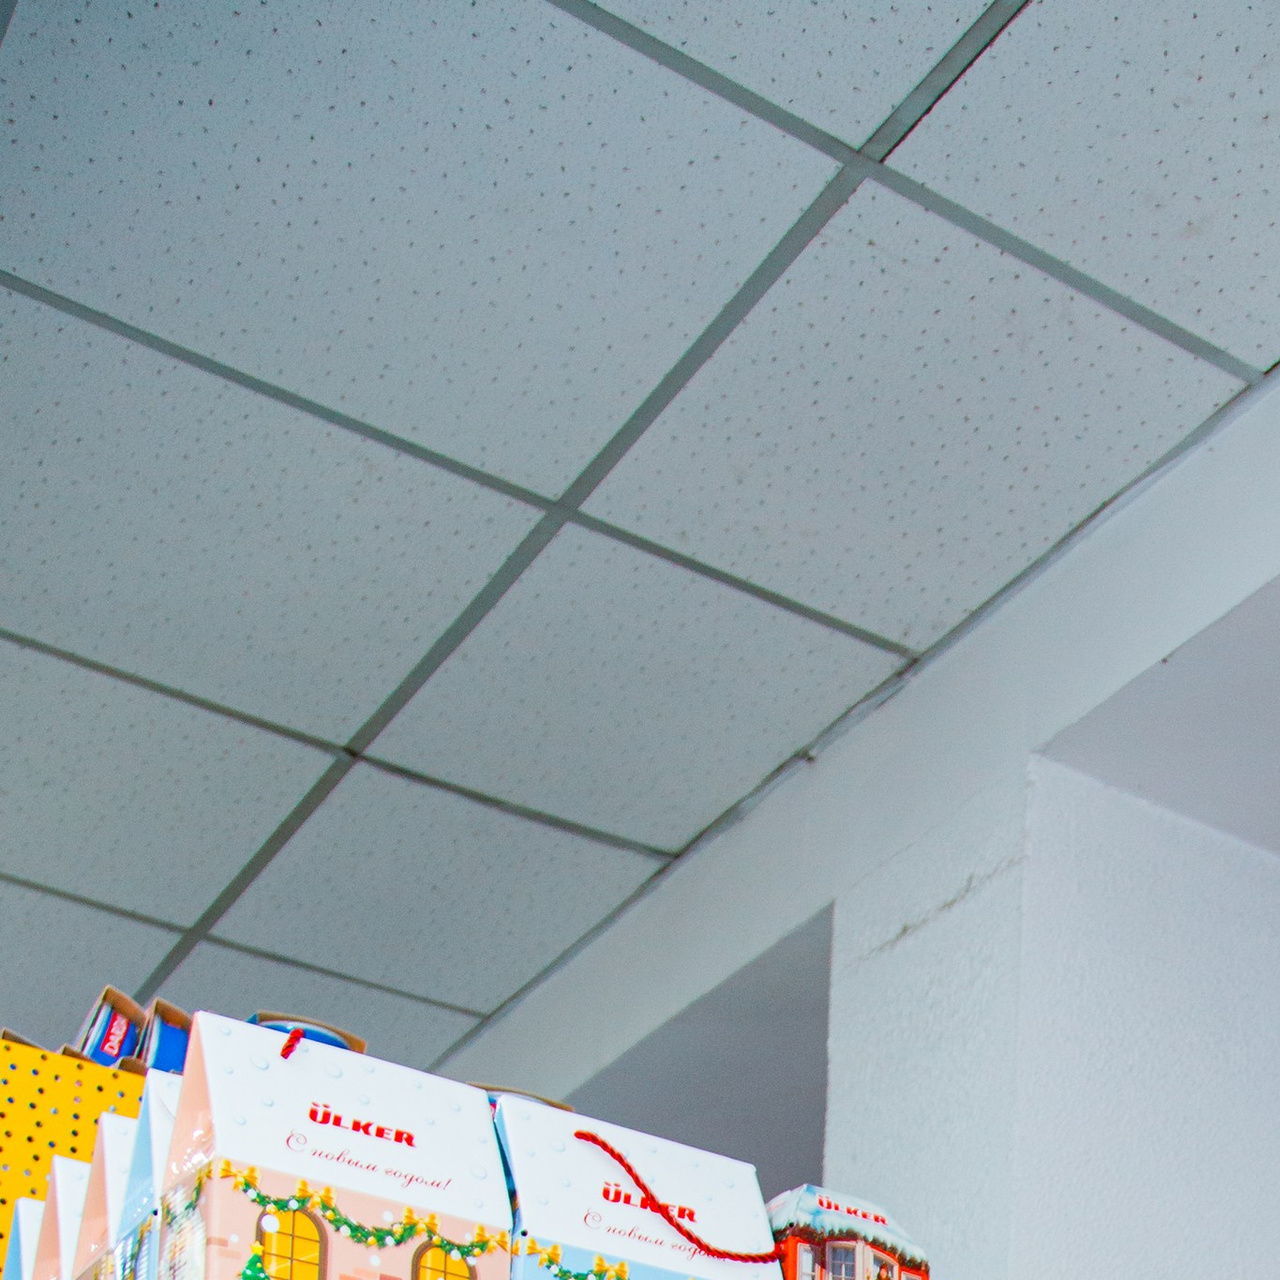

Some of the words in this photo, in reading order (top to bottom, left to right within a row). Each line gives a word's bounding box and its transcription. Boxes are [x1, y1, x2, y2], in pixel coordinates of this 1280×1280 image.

[308, 1101, 417, 1148] ÜLKER
[311, 1149, 379, 1173] новым
[384, 1166, 453, 1191] годом!
[818, 1194, 888, 1226] ÜLKER
[606, 1225, 665, 1247] новым
